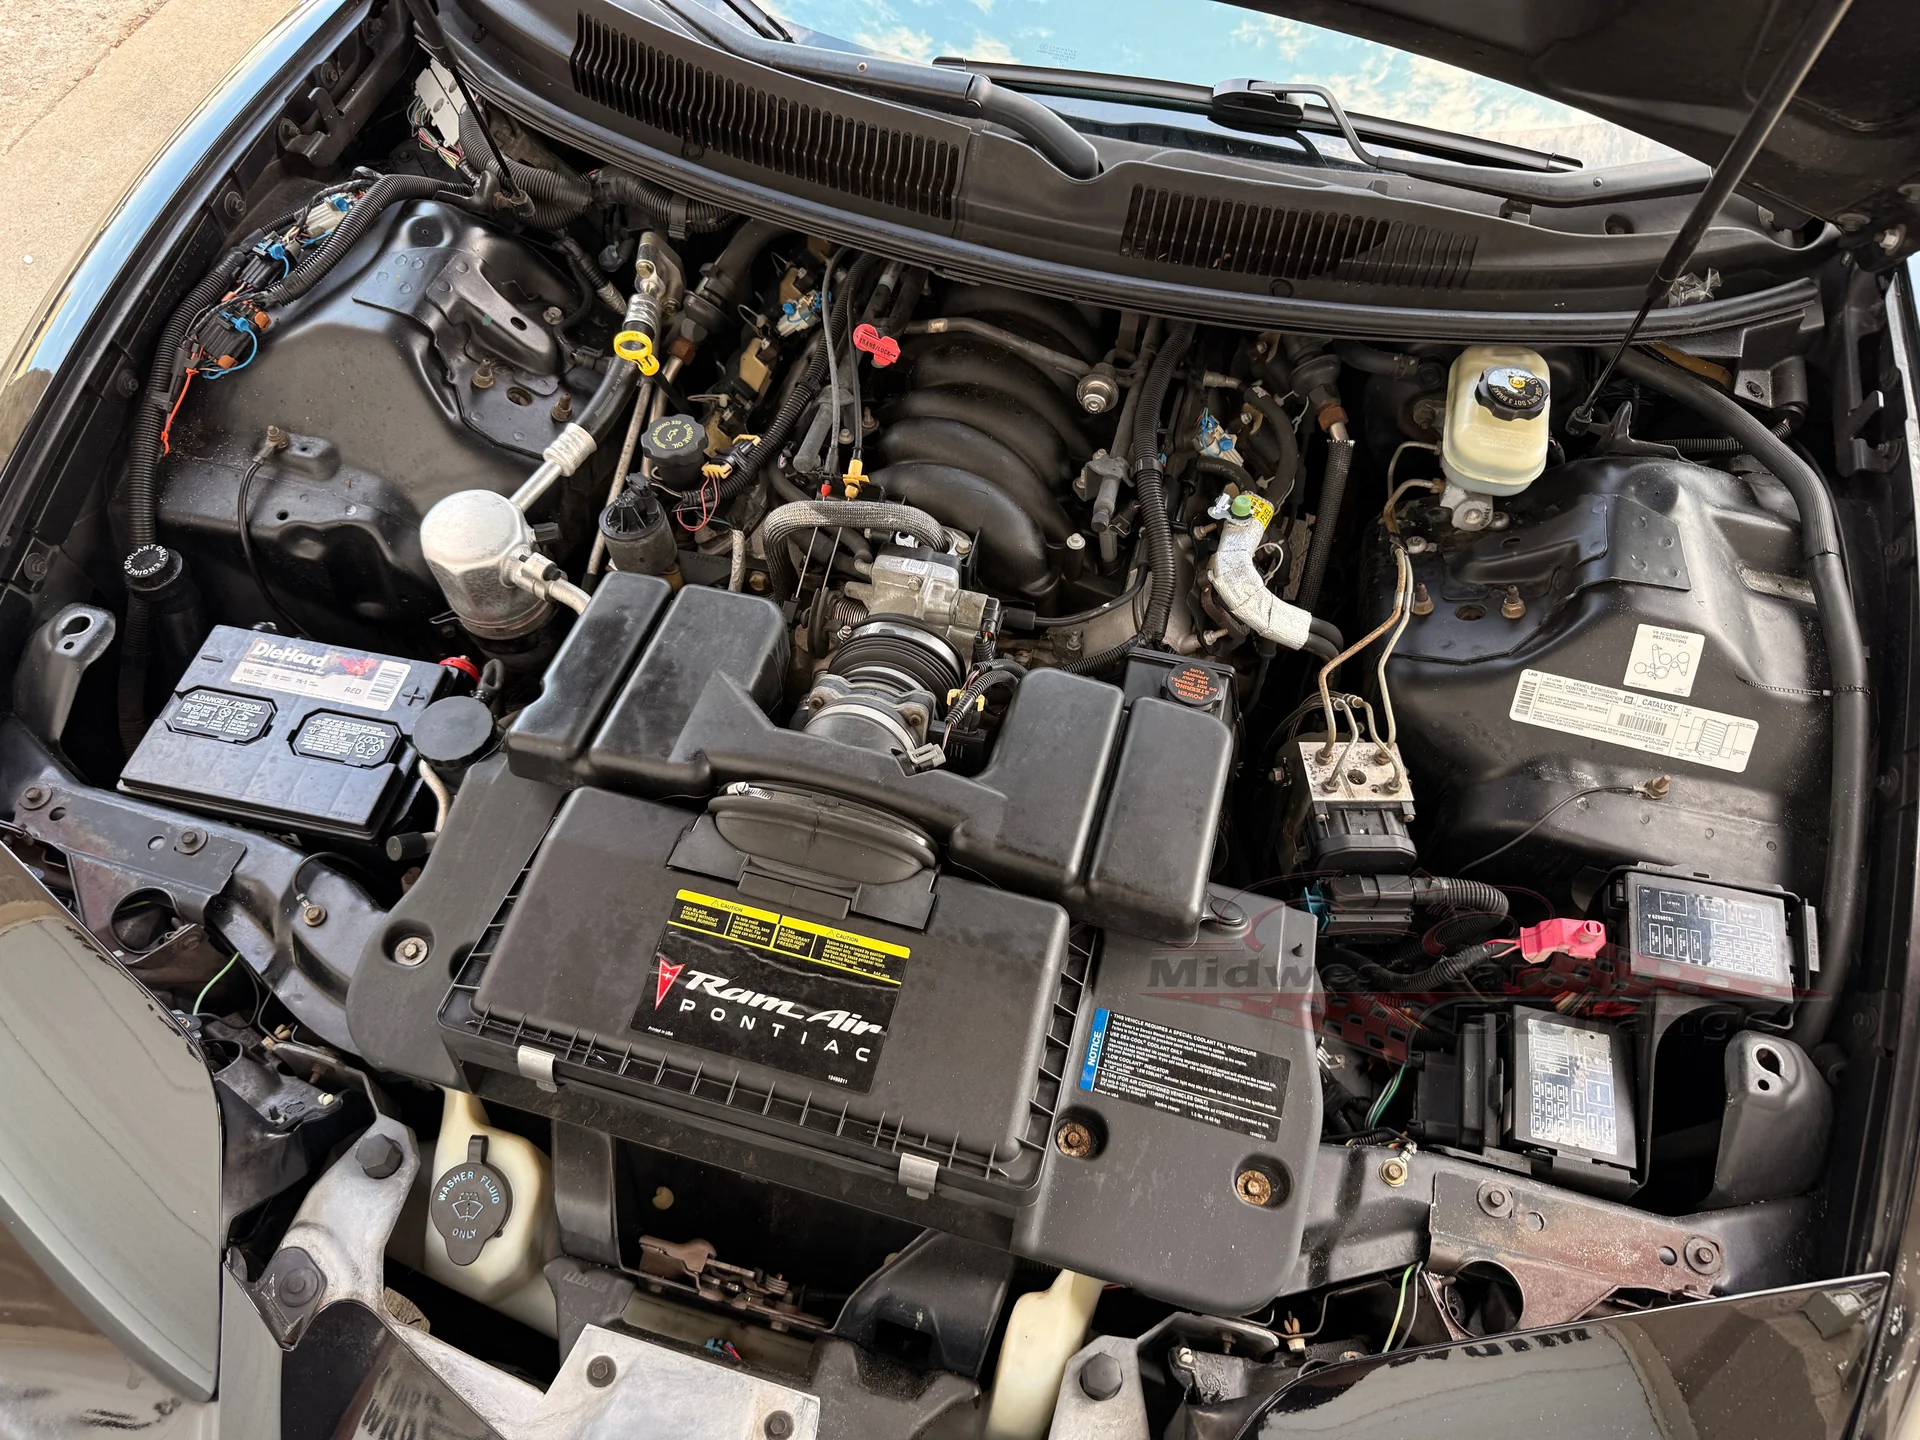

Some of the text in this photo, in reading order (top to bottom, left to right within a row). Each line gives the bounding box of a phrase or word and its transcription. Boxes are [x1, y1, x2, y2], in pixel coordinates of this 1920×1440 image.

[682, 424, 694, 443] ENGINE
[124, 544, 166, 576] COOLANT ONLY ENGINE
[252, 642, 330, 667] DieHard
[1175, 682, 1209, 695] STEERING
[1178, 690, 1204, 700] POWER
[1566, 685, 1588, 694] CONTROL
[1590, 691, 1623, 702] INFORMATION
[1573, 682, 1594, 690] VEHICLE
[1595, 687, 1618, 696] EMISSION
[198, 696, 230, 706] DANGER
[234, 702, 263, 711] POISON
[1642, 699, 1678, 713] CATALYST
[720, 903, 743, 913] CAUTION
[698, 914, 719, 923] WITHOUT
[780, 932, 810, 943] REFRIGERANT
[836, 933, 859, 943] CAUTION
[777, 941, 800, 950] PRESSURE
[685, 970, 883, 1035] Ram Air
[679, 999, 870, 1062] PONTIAC
[1125, 1017, 1144, 1026] VEHICLE
[1145, 1022, 1168, 1033] REQUIRES
[1173, 1030, 1193, 1040] SPECIAL
[1193, 1036, 1216, 1046] COOLANT
[1227, 1045, 1257, 1057] PROCEDURE
[1088, 1031, 1101, 1066] NOTICE
[1147, 1041, 1170, 1052] COOLANT
[1144, 1064, 1170, 1075] INDICATOR
[1138, 1081, 1170, 1094] CONDITIONED
[1171, 1090, 1194, 1101] VEHICLES
[1194, 1097, 1209, 1105] ONLY)
[438, 1171, 501, 1204] WASHER FLUID
[452, 1228, 477, 1239] ONLY
